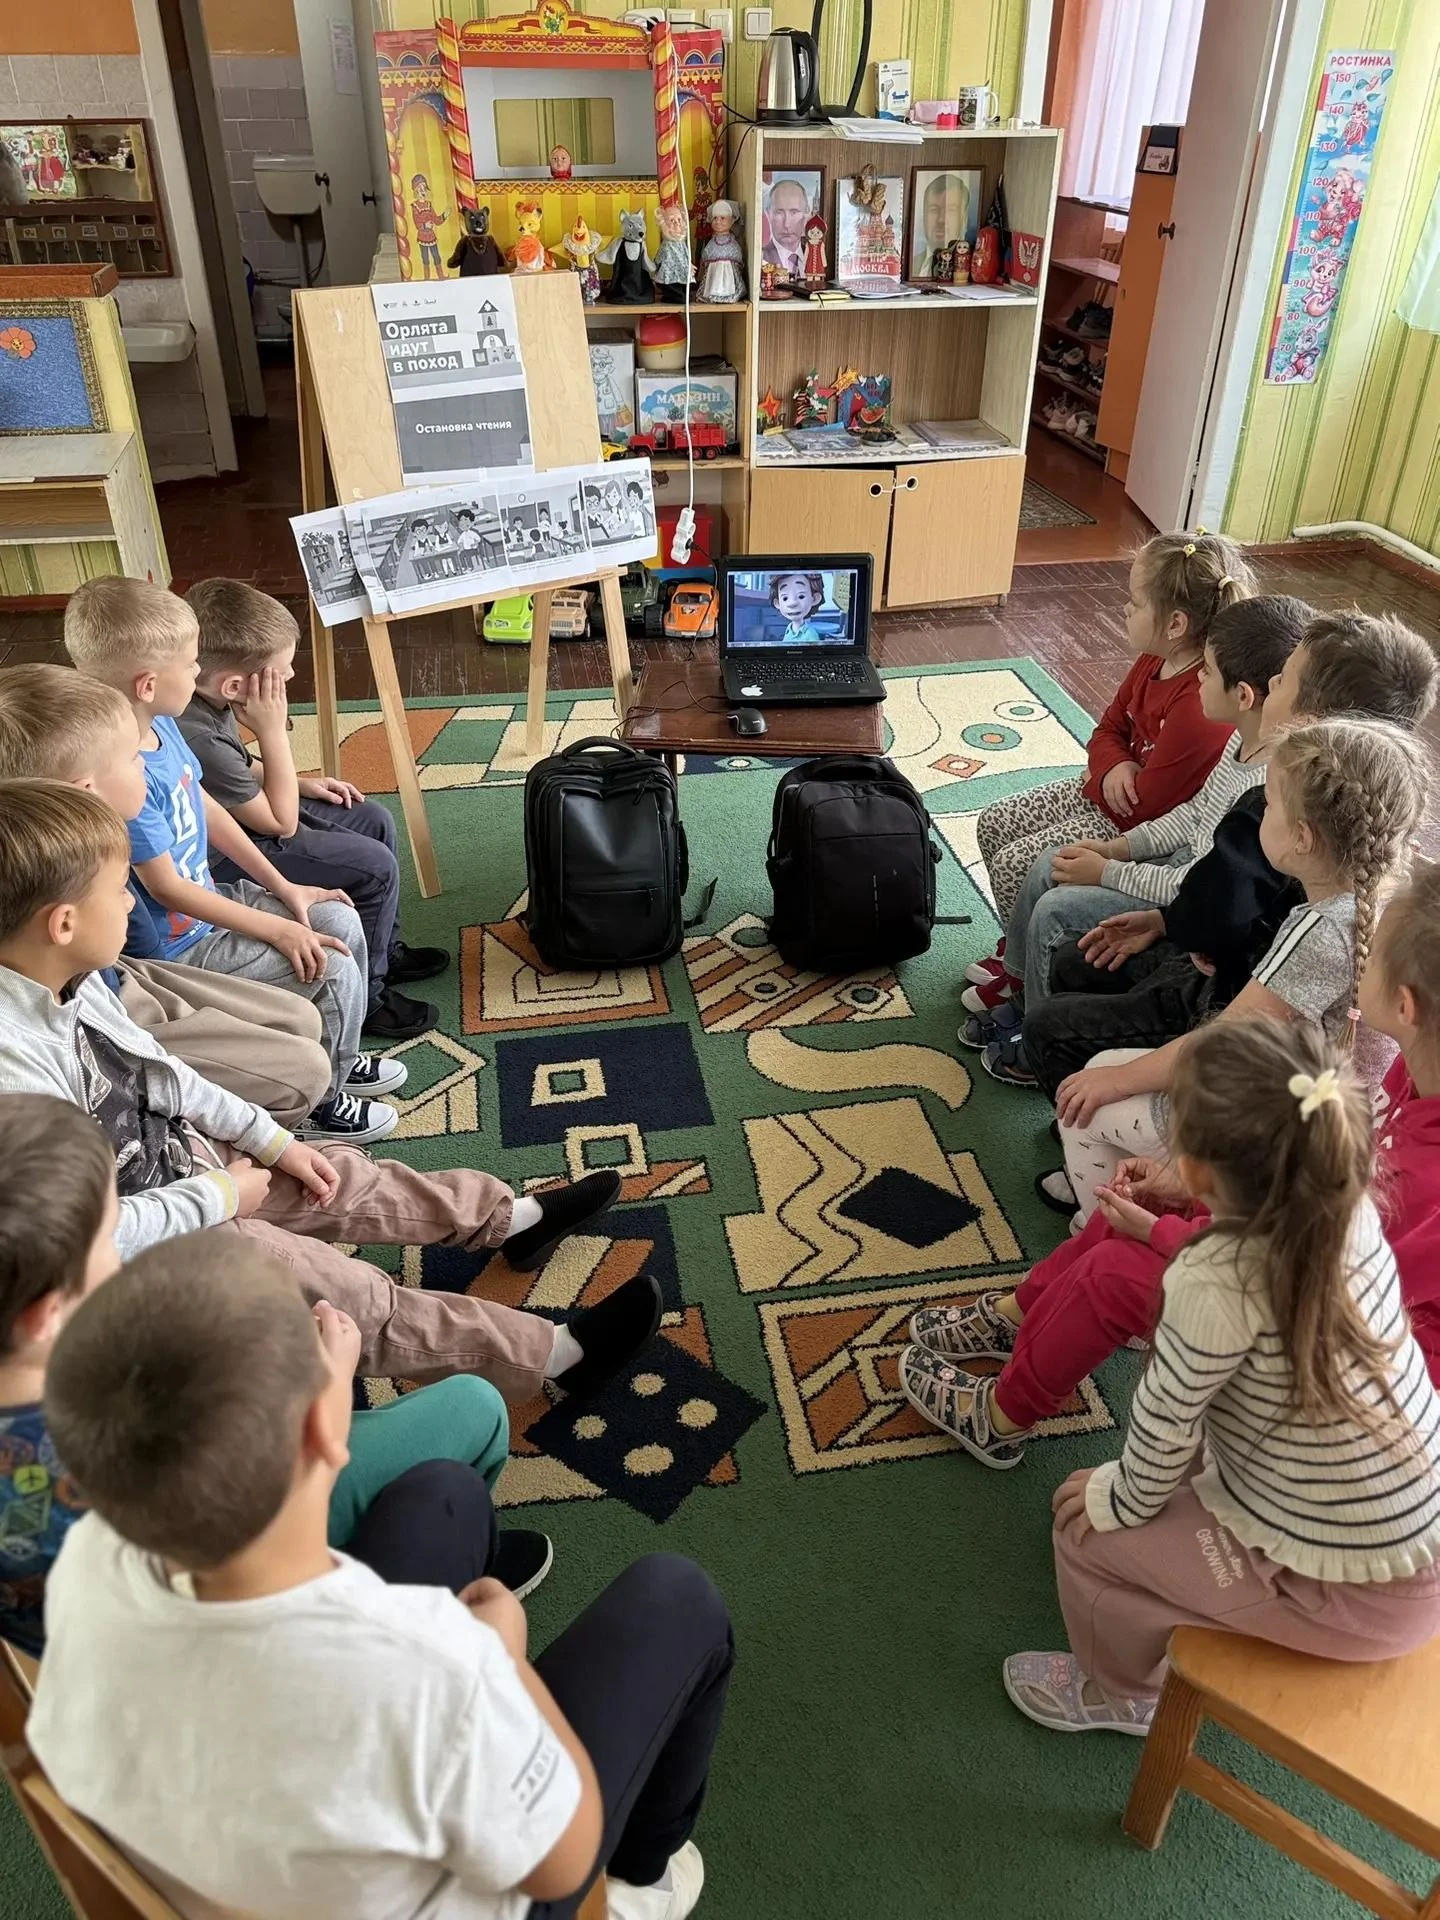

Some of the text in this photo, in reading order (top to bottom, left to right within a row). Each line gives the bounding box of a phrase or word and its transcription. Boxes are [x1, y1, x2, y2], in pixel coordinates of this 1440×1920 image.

[1330, 56, 1392, 66] РОСТИНКА
[1335, 73, 1351, 82] 150
[1329, 106, 1344, 114] 140
[1321, 142, 1336, 150] 130
[1313, 177, 1328, 186] 120
[1306, 212, 1320, 220] 110
[1300, 246, 1316, 254] 100
[851, 264, 889, 273] МОСКВА
[1294, 280, 1306, 288] 90
[1287, 312, 1300, 321] 80
[385, 321, 448, 340] Орлята
[389, 341, 429, 357] идут
[1280, 344, 1292, 352] 70
[393, 354, 459, 373] в поход
[1274, 374, 1287, 382] 60
[415, 420, 512, 434] Остановка чтения
[1196, 1528, 1233, 1588] GROWING
